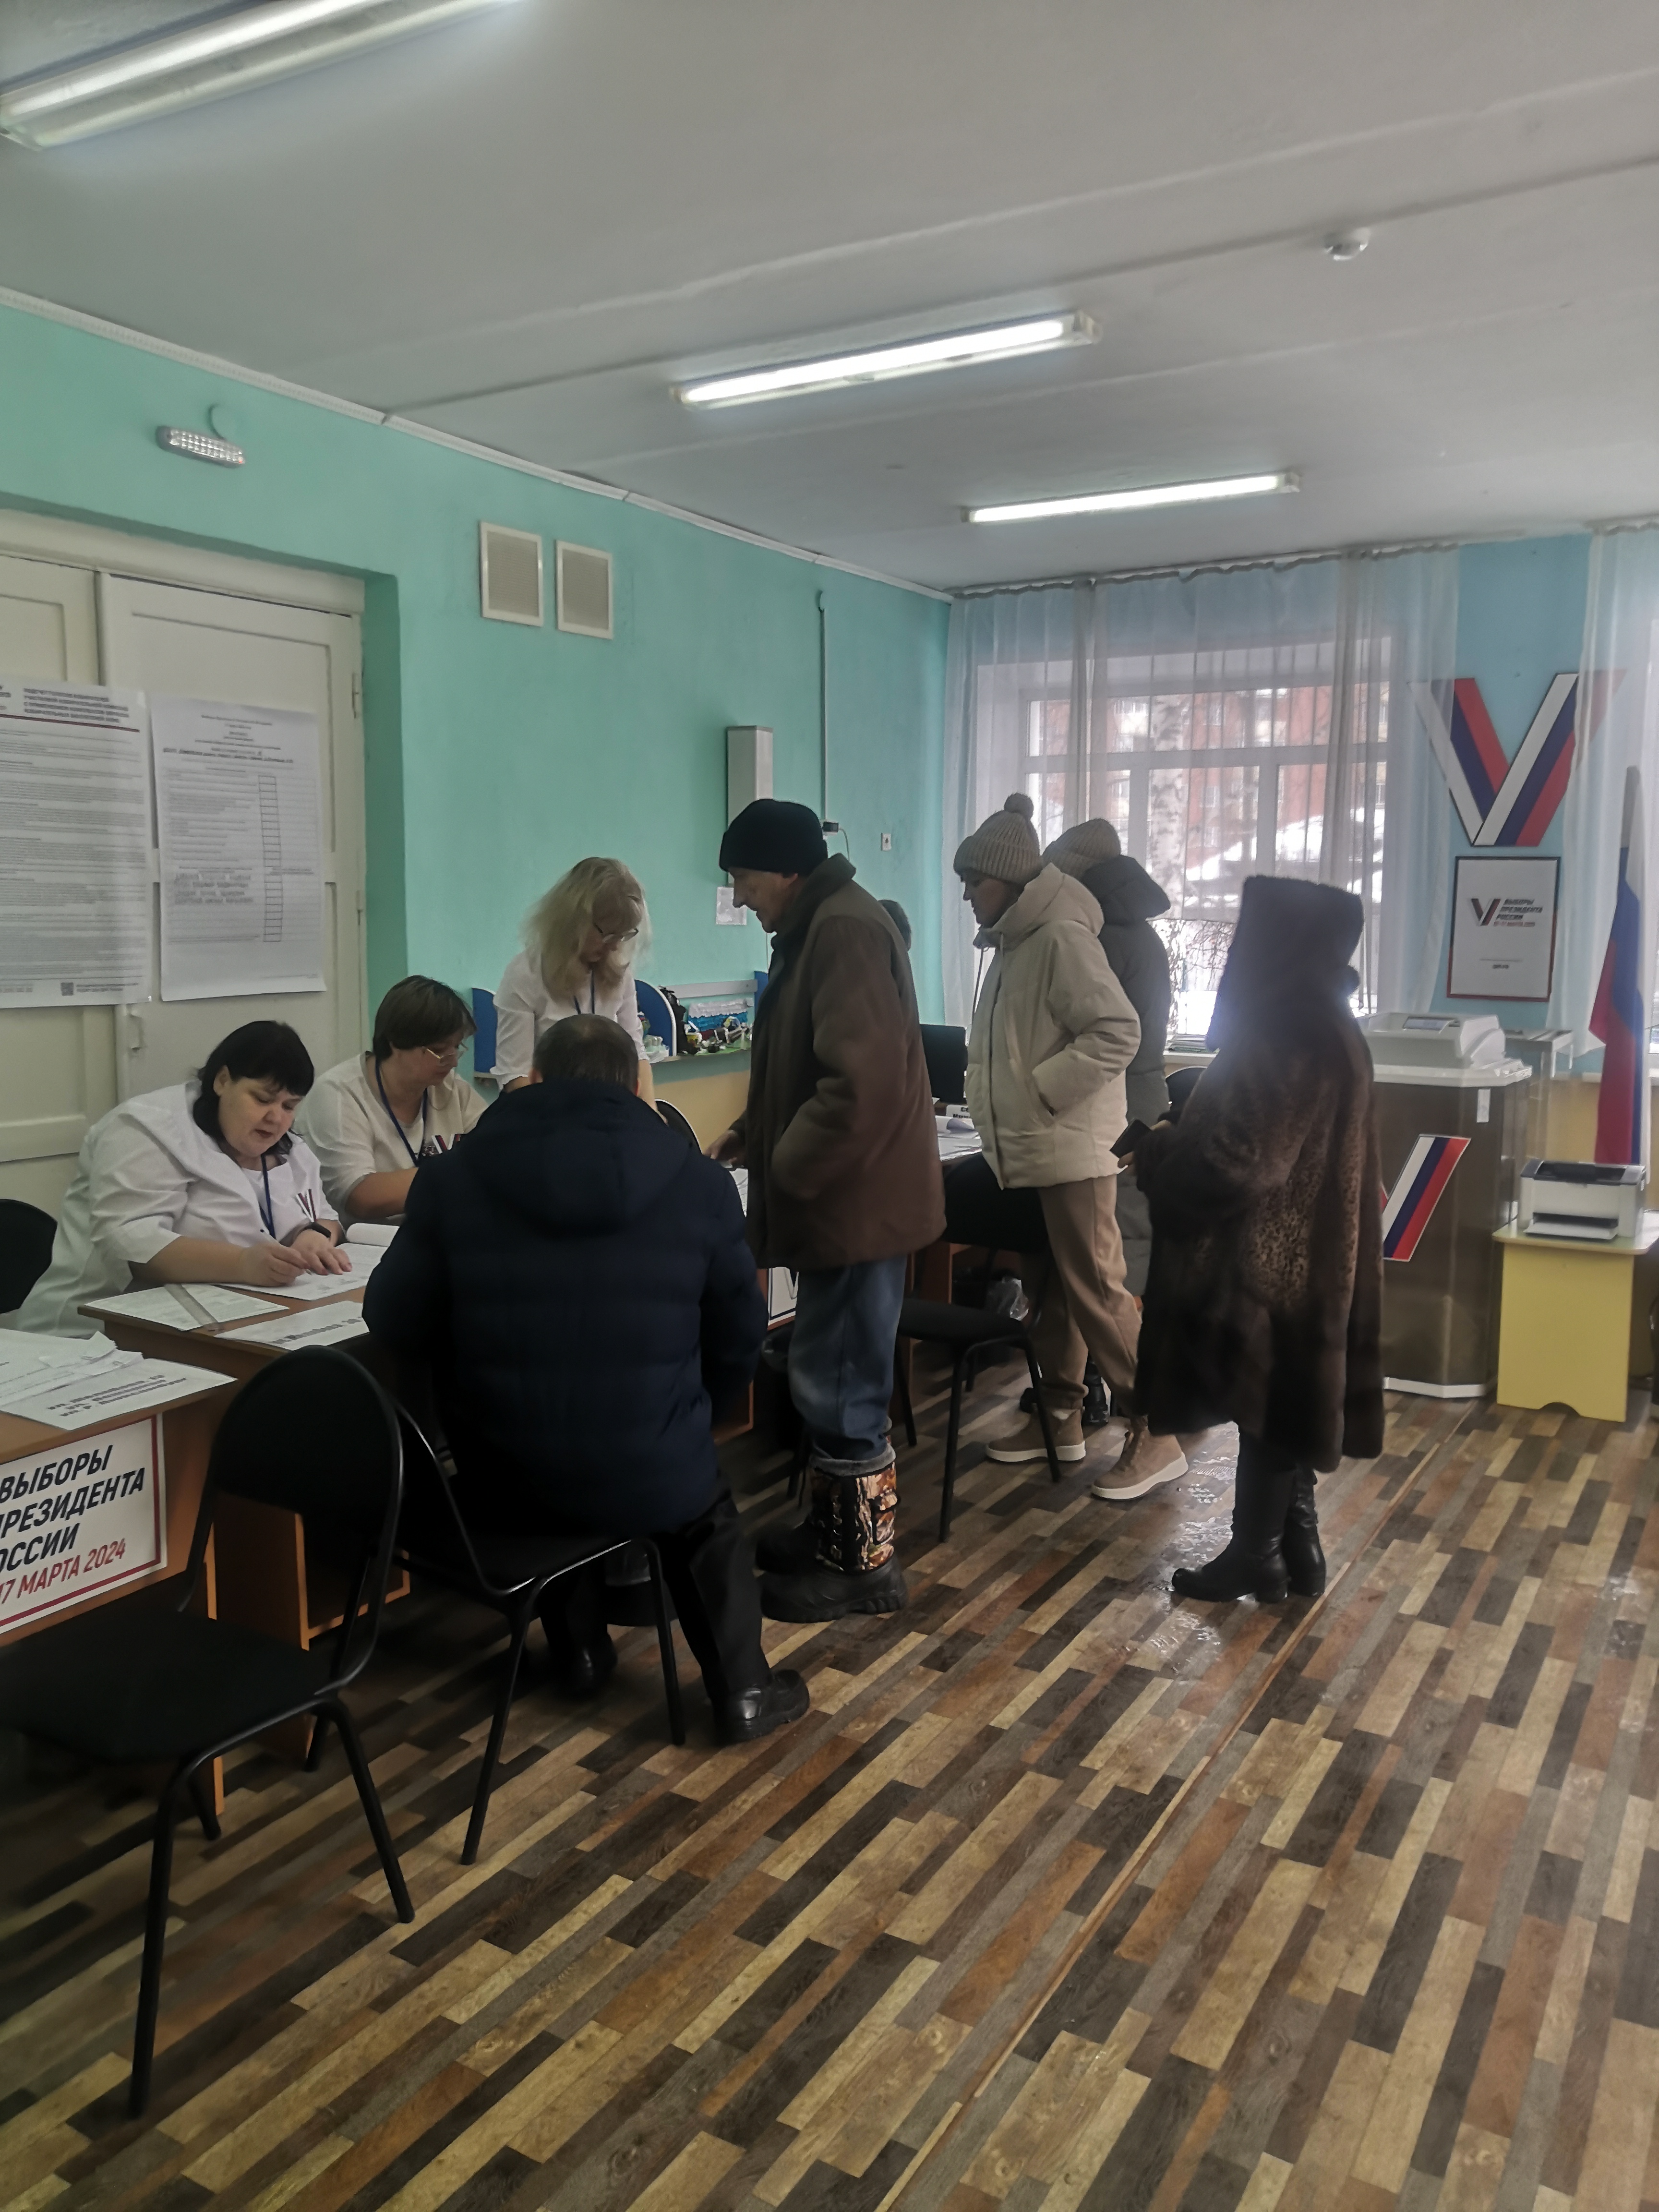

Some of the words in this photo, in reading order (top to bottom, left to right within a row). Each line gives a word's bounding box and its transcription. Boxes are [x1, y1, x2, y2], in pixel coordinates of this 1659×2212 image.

[0, 1444, 113, 1504] ВЫБОРЫ
[0, 1467, 145, 1539] РЕЗИДЕНТА
[17, 1554, 81, 1599] МАРТА
[83, 1538, 126, 1574] 2024
